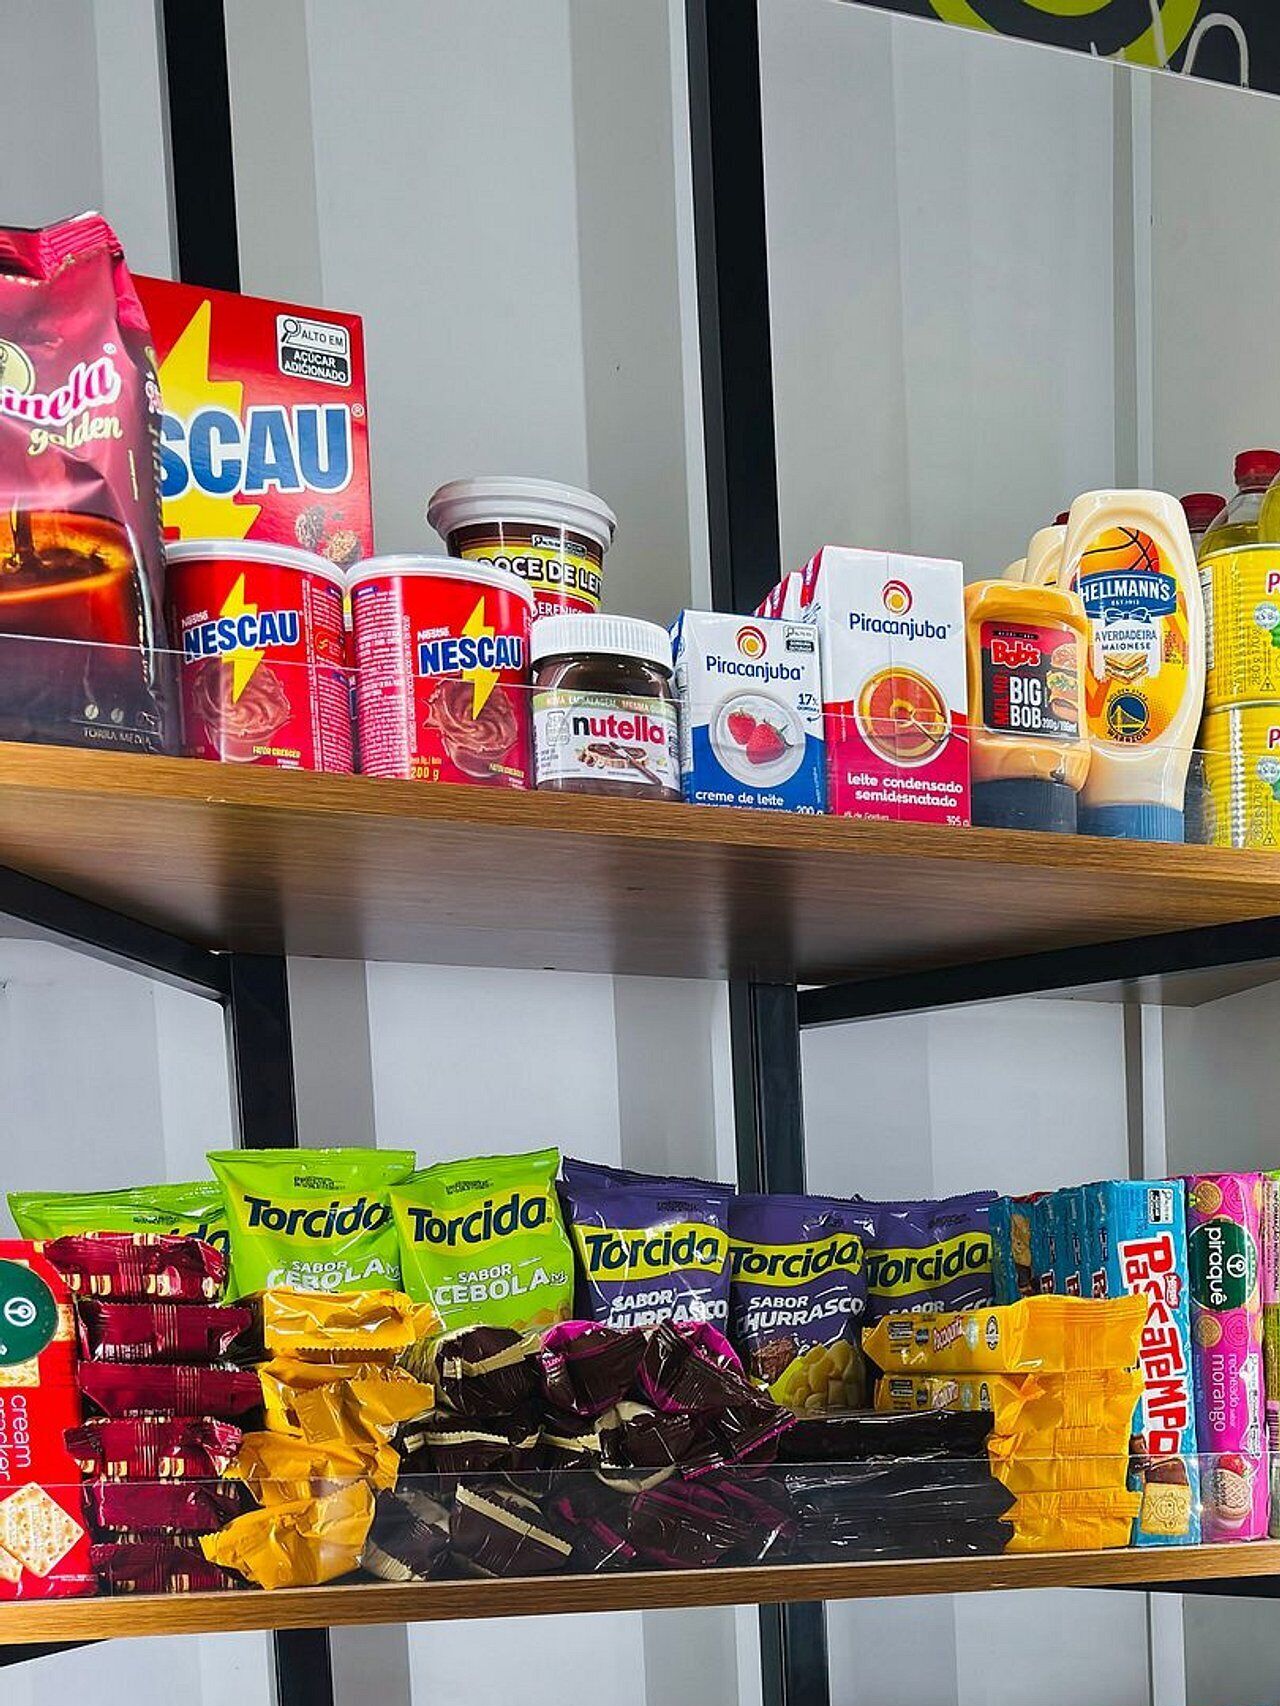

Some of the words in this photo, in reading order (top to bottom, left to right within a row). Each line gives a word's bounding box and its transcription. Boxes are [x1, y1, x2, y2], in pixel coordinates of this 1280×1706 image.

[302, 330, 326, 343] ALTO
[329, 335, 344, 347] EM
[284, 361, 346, 382] ADICIONADO
[294, 350, 336, 368] AÇÚCAR
[1080, 577, 1172, 603] HELLMANN'S
[184, 611, 299, 663] NESCAU
[849, 612, 946, 642] Piracanjuba
[419, 637, 523, 676] NESCAU
[991, 639, 1041, 669] Bob's
[1101, 641, 1152, 651] MAIONESE
[706, 655, 802, 684] Piracanjuba
[1010, 676, 1042, 705] BIG
[572, 714, 667, 745] nutella
[1011, 706, 1042, 729] BOB
[847, 771, 879, 788] leite
[882, 775, 964, 794] condensado
[695, 790, 734, 803] creme
[738, 790, 753, 804] de
[757, 792, 784, 806] leite
[855, 789, 958, 808] semidesnatado
[243, 1194, 390, 1239] Torcida
[408, 1194, 549, 1247] Torcida
[585, 1231, 720, 1273] Torcida
[731, 1238, 861, 1277] Torcida
[1204, 1226, 1226, 1306] piraquê
[292, 1260, 348, 1275] SABOR
[458, 1263, 511, 1283] SABOR
[434, 1272, 550, 1306] CEBOLA
[1208, 1354, 1226, 1432] morango
[11, 1394, 31, 1468] cream
